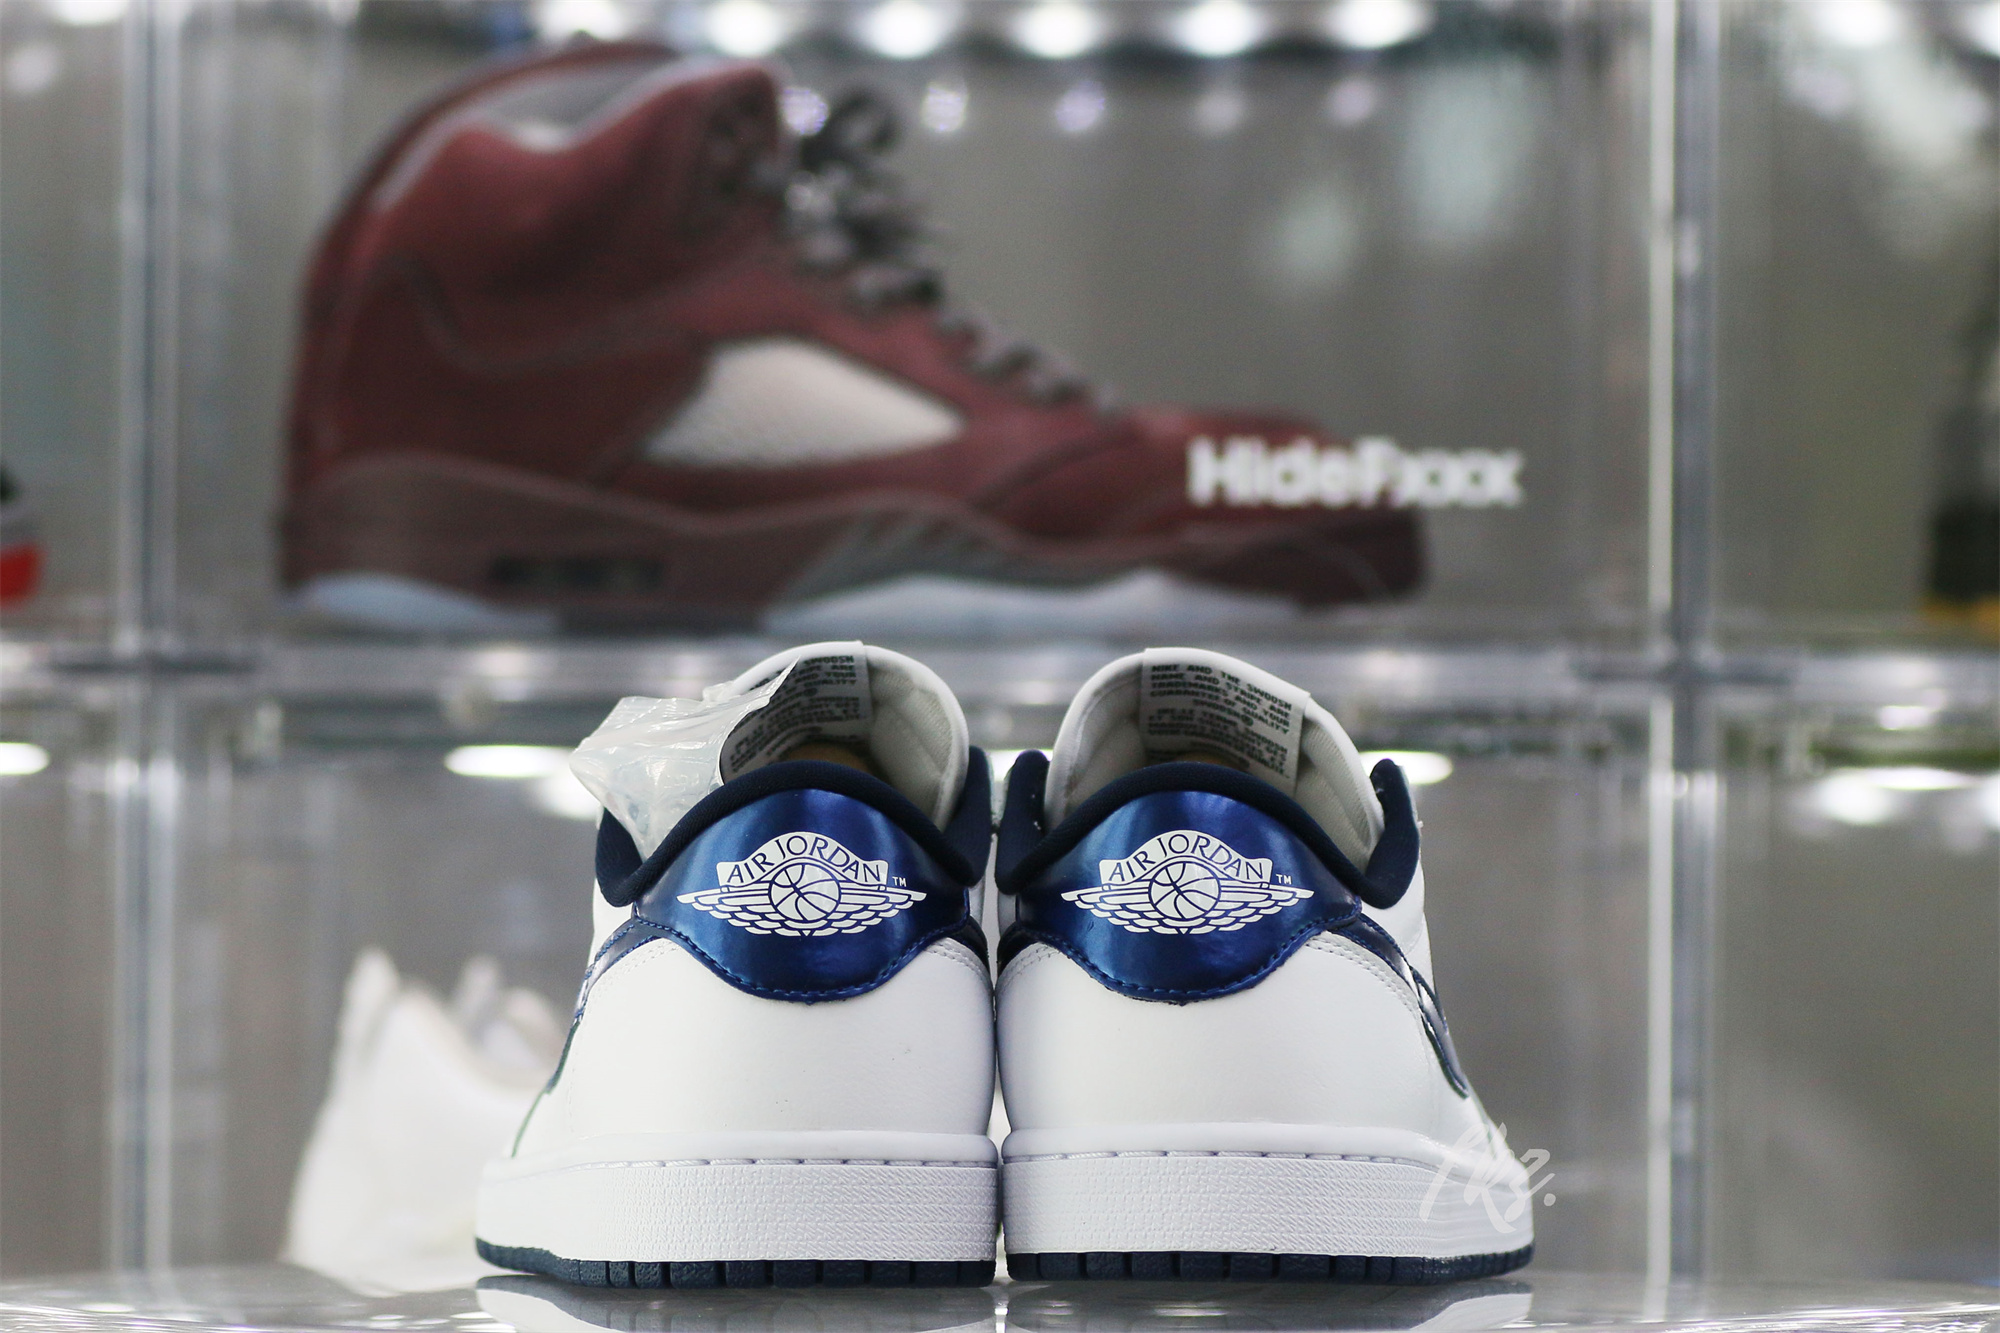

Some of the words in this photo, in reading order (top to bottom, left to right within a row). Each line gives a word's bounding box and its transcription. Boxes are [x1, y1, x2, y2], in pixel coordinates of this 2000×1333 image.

[1186, 664, 1213, 675] AND
[1246, 682, 1292, 711] SWOOSH
[727, 851, 775, 884] AIR
[774, 835, 881, 884] JORDAN
[1108, 850, 1156, 882] AIR
[1156, 833, 1264, 881] JORDAN
